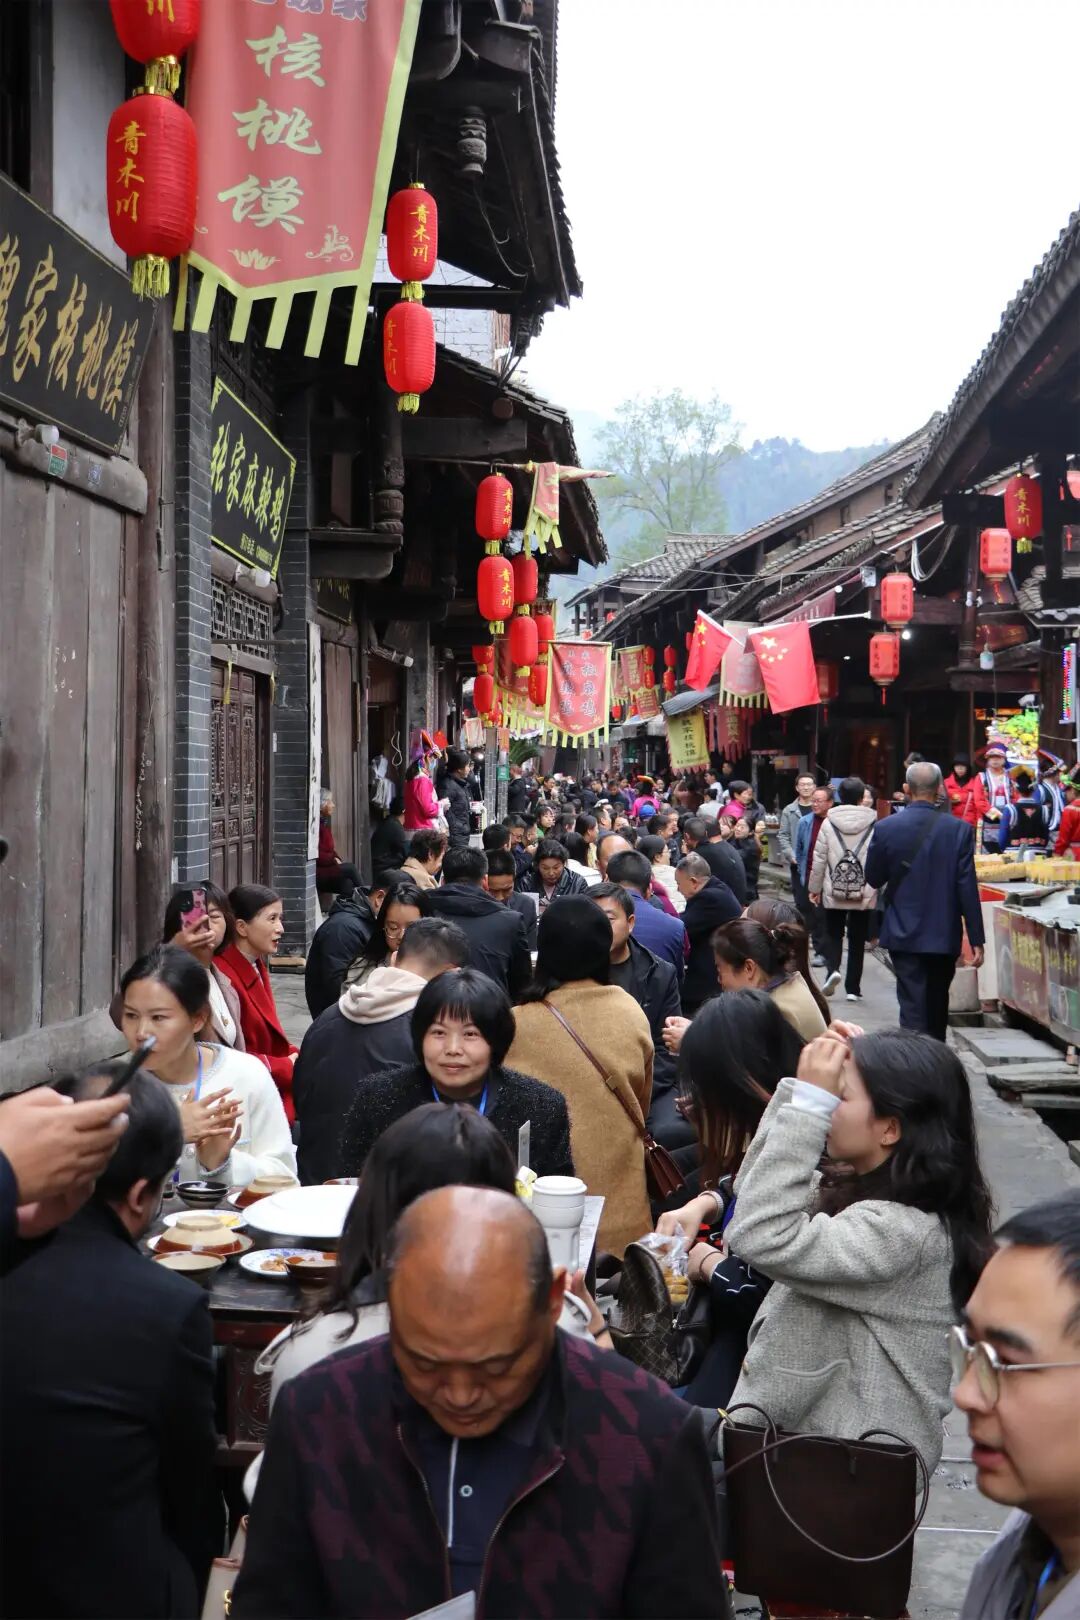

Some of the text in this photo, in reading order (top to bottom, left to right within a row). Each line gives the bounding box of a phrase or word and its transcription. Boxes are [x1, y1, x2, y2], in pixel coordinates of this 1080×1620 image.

[217, 25, 326, 235] 核桃馍
[115, 120, 148, 223] 青木川
[410, 203, 431, 263] 青木川
[502, 487, 513, 528] 青木川
[1013, 487, 1033, 528] 青木川
[499, 567, 513, 609] 青木川
